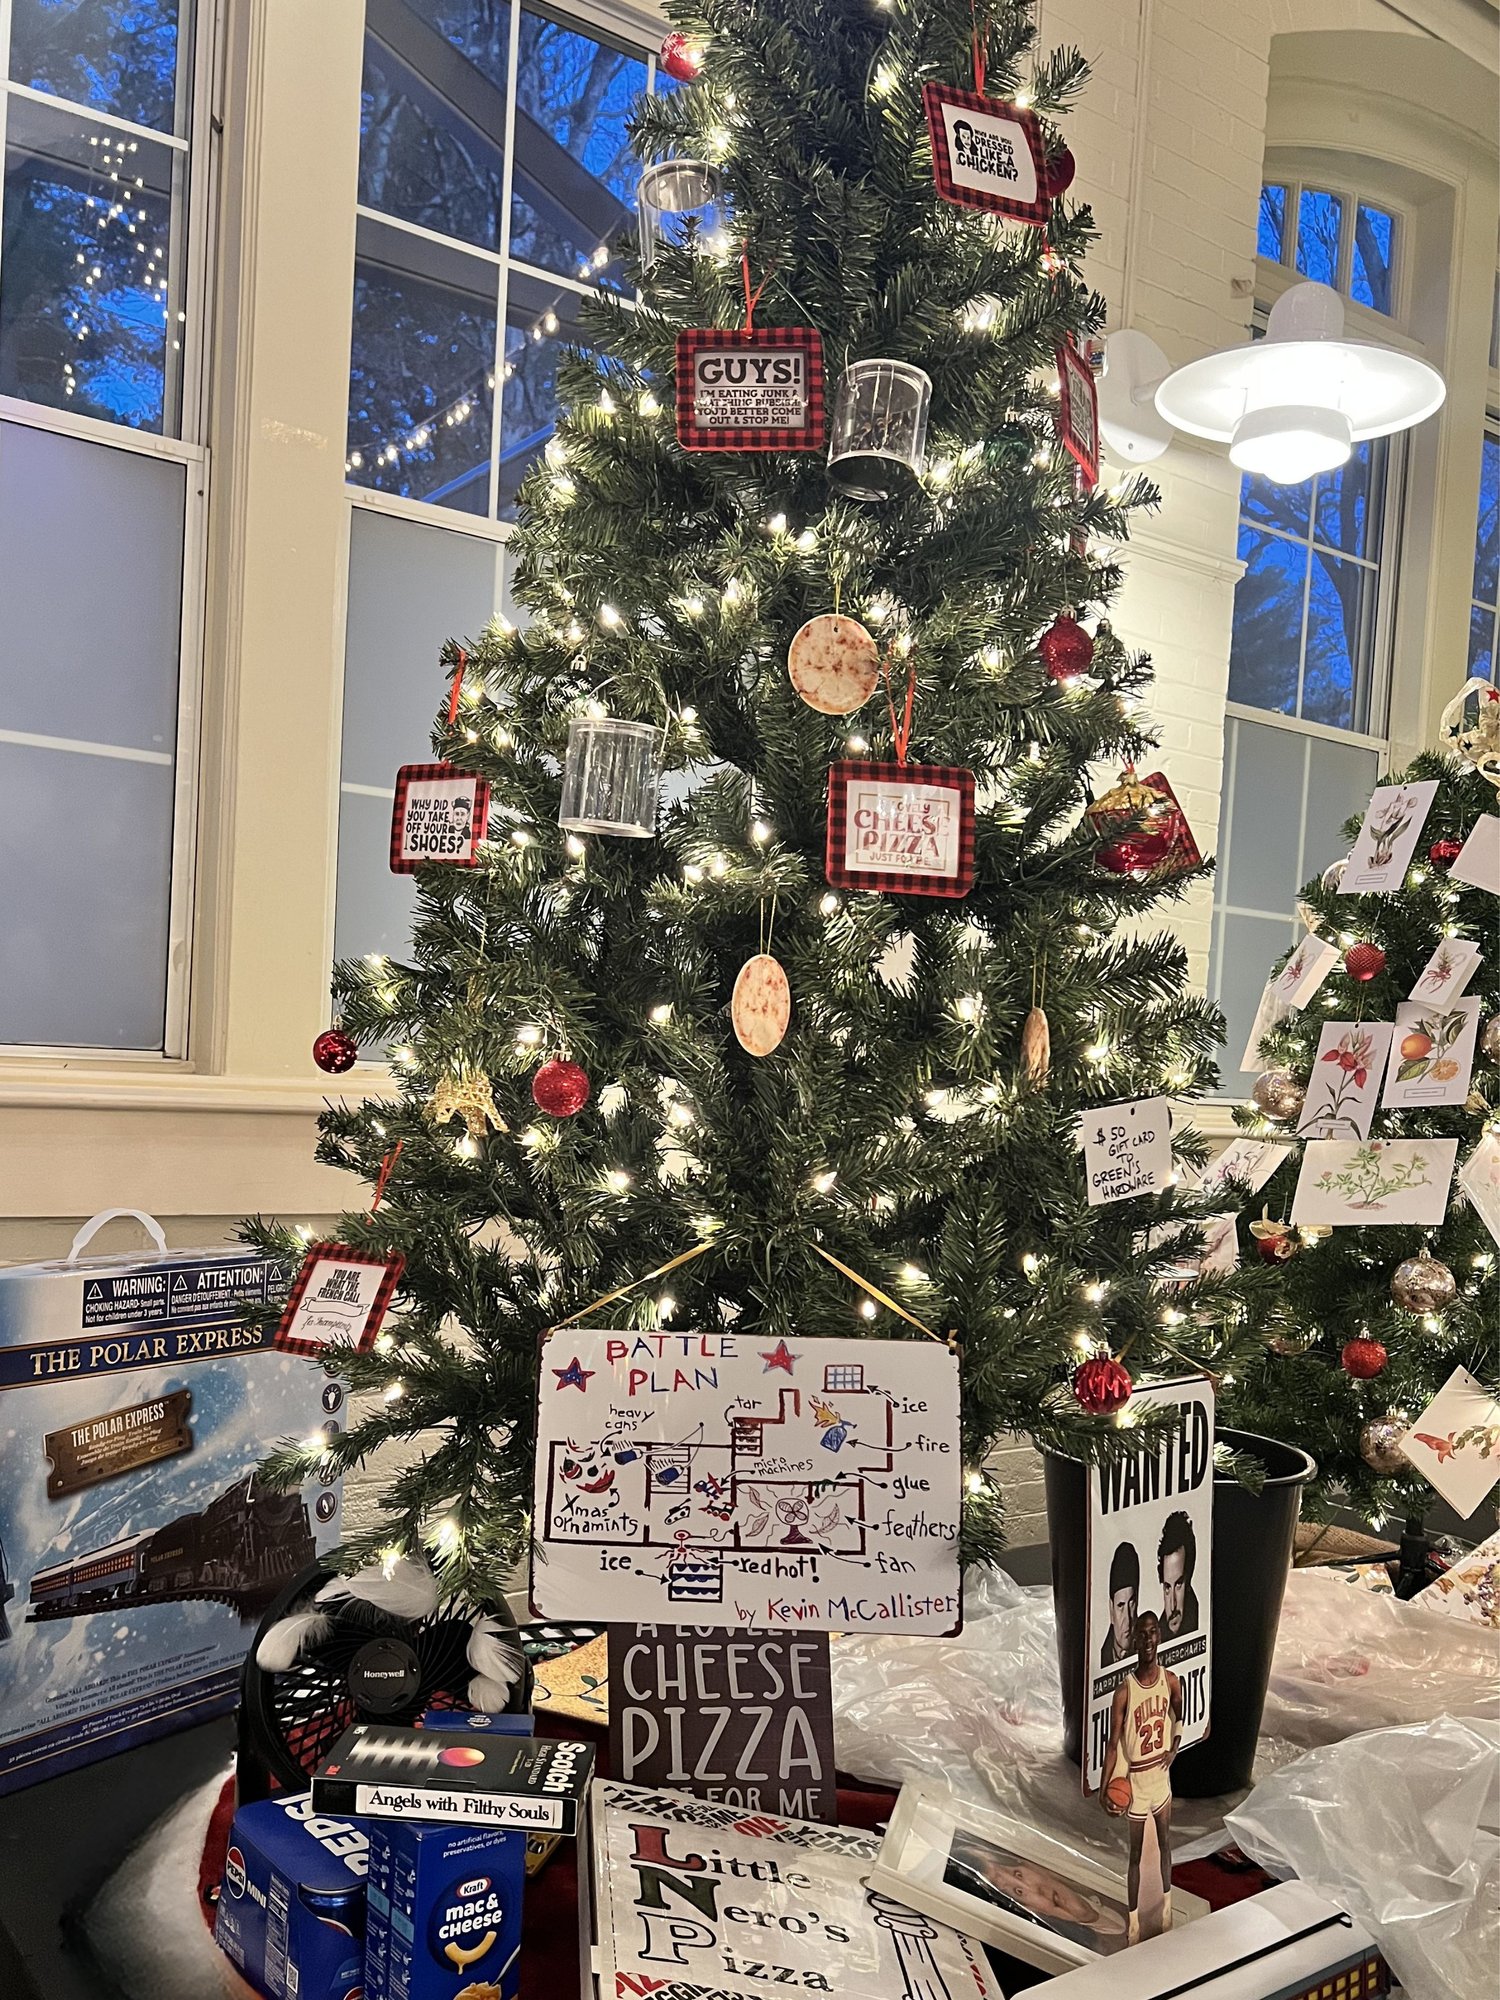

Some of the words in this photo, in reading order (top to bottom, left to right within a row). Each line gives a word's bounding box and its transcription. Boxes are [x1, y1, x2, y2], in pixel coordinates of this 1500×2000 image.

[975, 136, 1014, 155] DRESSED
[958, 152, 1019, 182] CHICKEN?
[980, 147, 1002, 162] LIKE
[1004, 154, 1015, 168] A
[699, 358, 801, 385] GUYS!
[700, 390, 715, 398] I'M
[719, 390, 758, 398] EATING
[761, 390, 789, 398] JUNK
[699, 408, 728, 416] YOU'D
[731, 408, 769, 416] BETTER
[772, 408, 801, 416] COME
[710, 417, 731, 425] OUT
[734, 417, 740, 425] &
[743, 417, 769, 425] STOP
[772, 417, 790, 425] ME!
[412, 799, 431, 810] WHY
[434, 800, 449, 811] DID
[407, 811, 425, 822] YOU
[429, 812, 449, 823] TAKE
[854, 810, 951, 837] CHEESE
[406, 823, 422, 833] OFF
[424, 823, 448, 834] YOUR
[410, 835, 464, 854] SHOES?
[863, 831, 940, 858] PIZZA
[870, 853, 893, 862] JUST
[1109, 1139, 1130, 1157] GIFT
[1133, 1131, 1155, 1147] CARD
[1117, 1154, 1134, 1164] TO
[1093, 1161, 1141, 1188] GREEN'S
[1102, 1172, 1155, 1200] HARDWARE
[197, 1268, 263, 1290] ATTENTION:
[326, 1279, 346, 1290] WHAT
[346, 1281, 360, 1291] THE
[333, 1269, 347, 1280] YOU
[347, 1272, 361, 1281] ARE
[113, 1276, 166, 1297] WARNING:
[317, 1288, 343, 1300] FRENCH
[86, 1302, 113, 1314] CHOKING
[140, 1299, 153, 1308] Small
[154, 1298, 166, 1308] parts.
[172, 1294, 193, 1305] DANGER
[86, 1315, 96, 1324] Not
[105, 1311, 127, 1322] children
[128, 1310, 143, 1319] under
[148, 1309, 164, 1318] years.
[30, 1349, 81, 1376] THE
[90, 1337, 168, 1368] POLAR
[177, 1325, 263, 1356] EXPRESS
[607, 1335, 739, 1365] BATTLE
[629, 1367, 719, 1396] PLAN
[610, 1404, 655, 1423] heavy
[734, 1395, 762, 1410] tar
[901, 1397, 928, 1414] ice
[71, 1427, 91, 1448] THE
[93, 1416, 124, 1441] POLAR
[126, 1402, 165, 1430] EXPRESS
[606, 1420, 639, 1431] cans
[915, 1435, 951, 1453] fire
[754, 1457, 787, 1469] micro
[758, 1459, 814, 1477] machines
[1100, 1401, 1209, 1515] WANTED
[893, 1475, 930, 1499] glue
[561, 1494, 608, 1518] Xmas
[554, 1512, 639, 1536] ornamints
[882, 1509, 957, 1541] feathers
[600, 1550, 632, 1571] ice
[875, 1552, 916, 1574] fan
[735, 1601, 756, 1629] by
[768, 1598, 820, 1623] Kevin
[829, 1593, 957, 1622] McCallister
[364, 1670, 405, 1679] Honeywell
[623, 1643, 819, 1701] CHEESE
[1134, 1695, 1169, 1734] BULLS
[622, 1706, 823, 1781] PIZZA
[1092, 1706, 1113, 1771] TH
[1140, 1720, 1165, 1757] 23
[542, 1742, 587, 1793] Scotch
[369, 1790, 422, 1812] Angels
[425, 1795, 458, 1812] with
[463, 1798, 507, 1820] Filthy
[509, 1802, 550, 1821] Souls
[443, 1843, 484, 1858] preservatives,
[486, 1841, 494, 1849] or
[494, 1836, 507, 1848] dyes
[458, 1836, 483, 1846] artificial
[628, 1824, 811, 1889] Little
[227, 1862, 245, 1884] PEPSI
[247, 1880, 267, 1909] MINI
[463, 1881, 484, 1897] Kraft
[446, 1900, 485, 1922] mac
[486, 1893, 498, 1910] &
[631, 1865, 851, 1944] Nero's
[637, 1911, 835, 1993] Pizza
